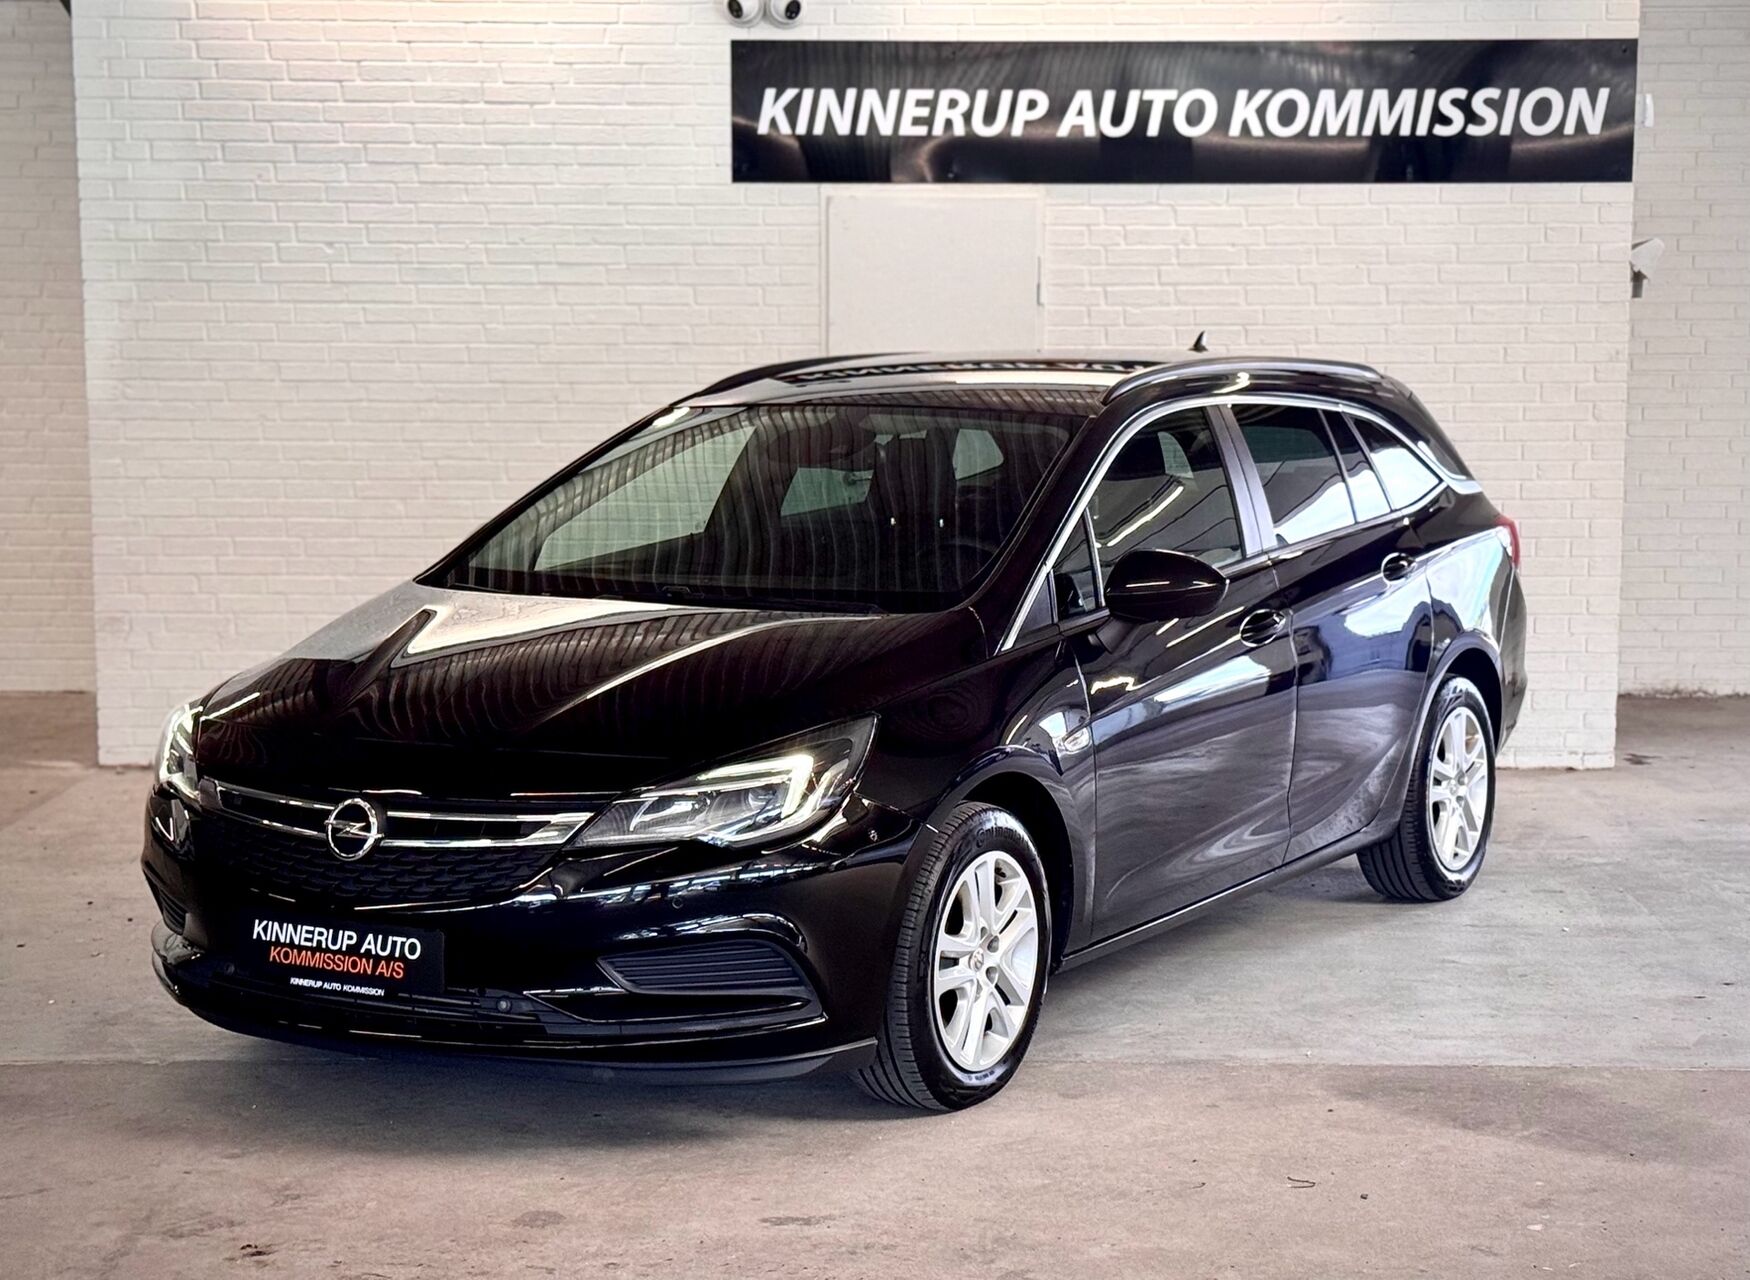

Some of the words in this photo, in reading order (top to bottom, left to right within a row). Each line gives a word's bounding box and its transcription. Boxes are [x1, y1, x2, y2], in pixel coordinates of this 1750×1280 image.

[757, 87, 1050, 137] KINNERUP
[1055, 88, 1219, 138] AUTO
[1227, 87, 1610, 138] KOMMISSION
[252, 918, 357, 952] KINNERUP
[360, 933, 422, 960] AUTO
[269, 945, 373, 975] KOMMISSION
[375, 962, 405, 979] A/S
[289, 976, 323, 989] KINNERUP
[322, 982, 342, 992] AUTO
[342, 984, 385, 997] KOMMISSION
